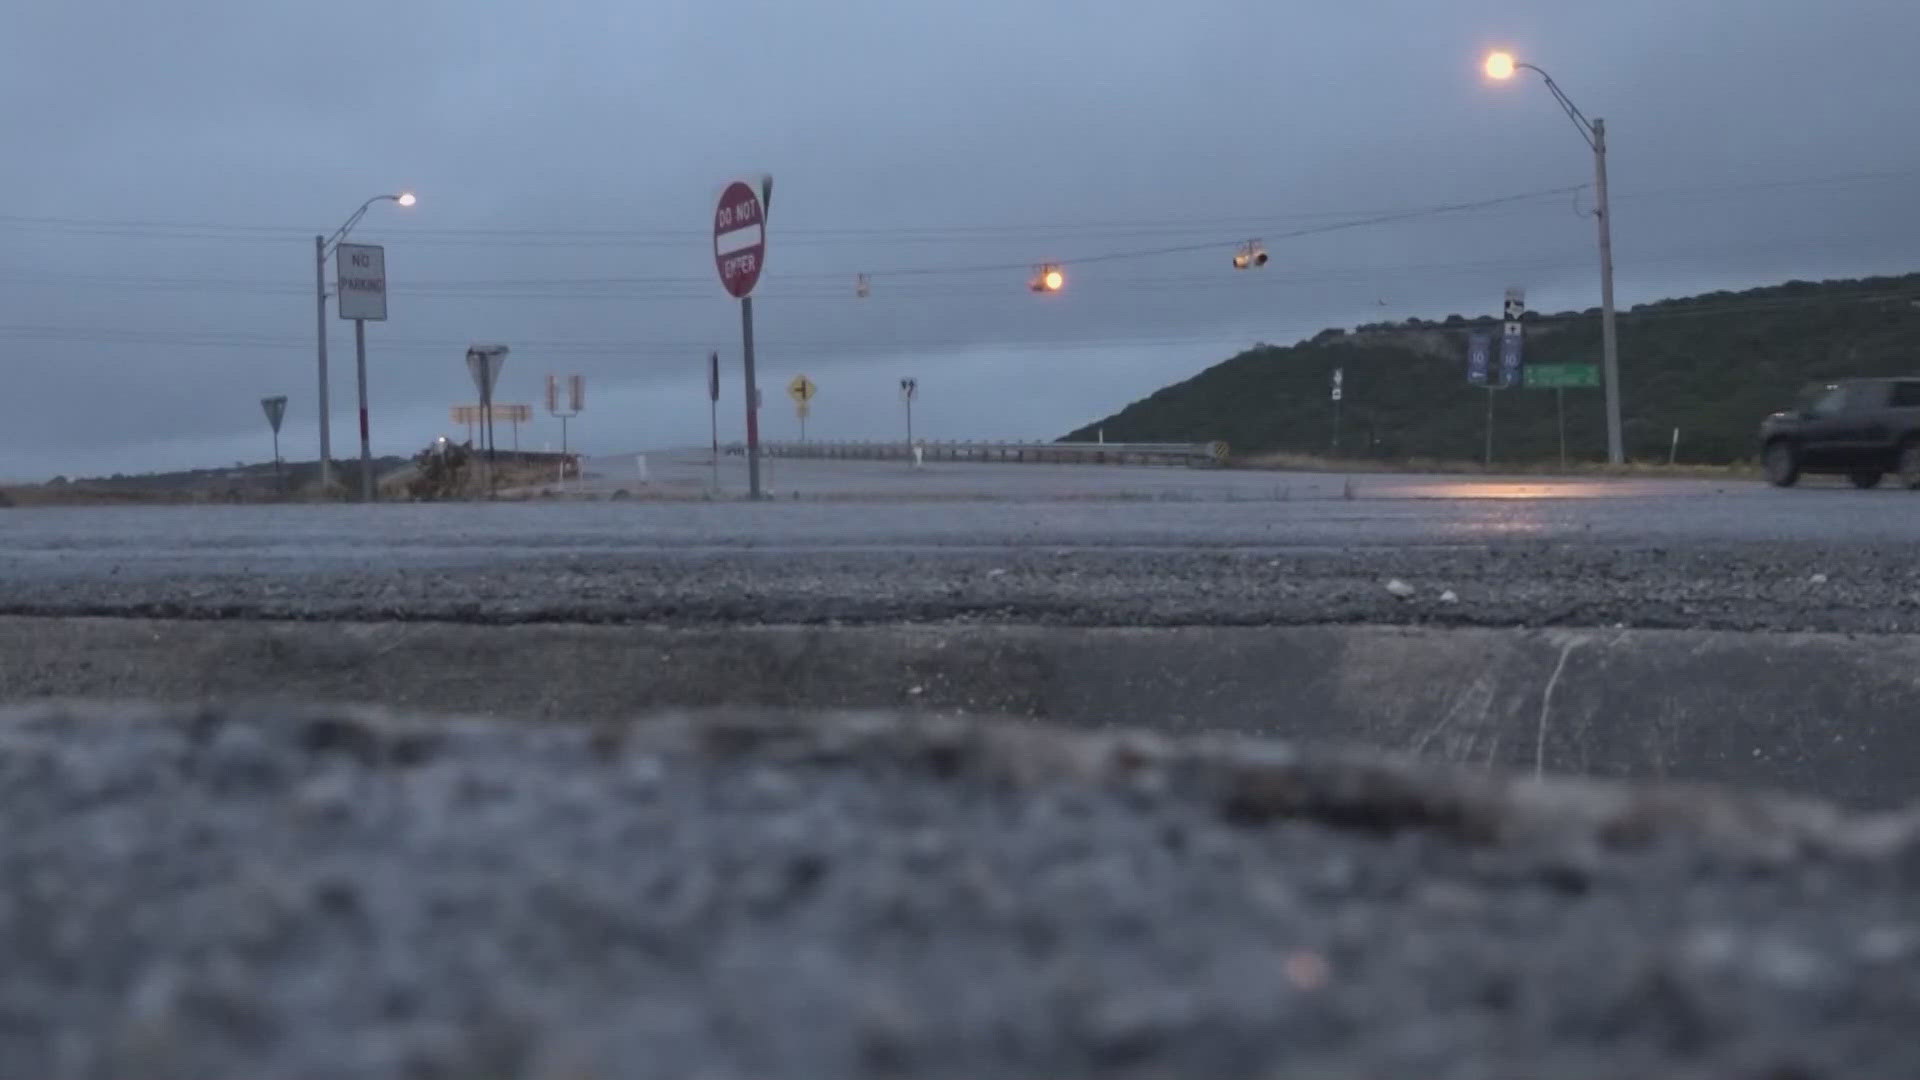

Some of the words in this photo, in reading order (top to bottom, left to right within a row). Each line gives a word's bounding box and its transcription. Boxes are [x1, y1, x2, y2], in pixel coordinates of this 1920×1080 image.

[719, 207, 733, 228] DO
[736, 199, 756, 222] NOT
[352, 255, 370, 268] NO
[725, 254, 756, 279] ENTER
[1472, 351, 1485, 365] 10
